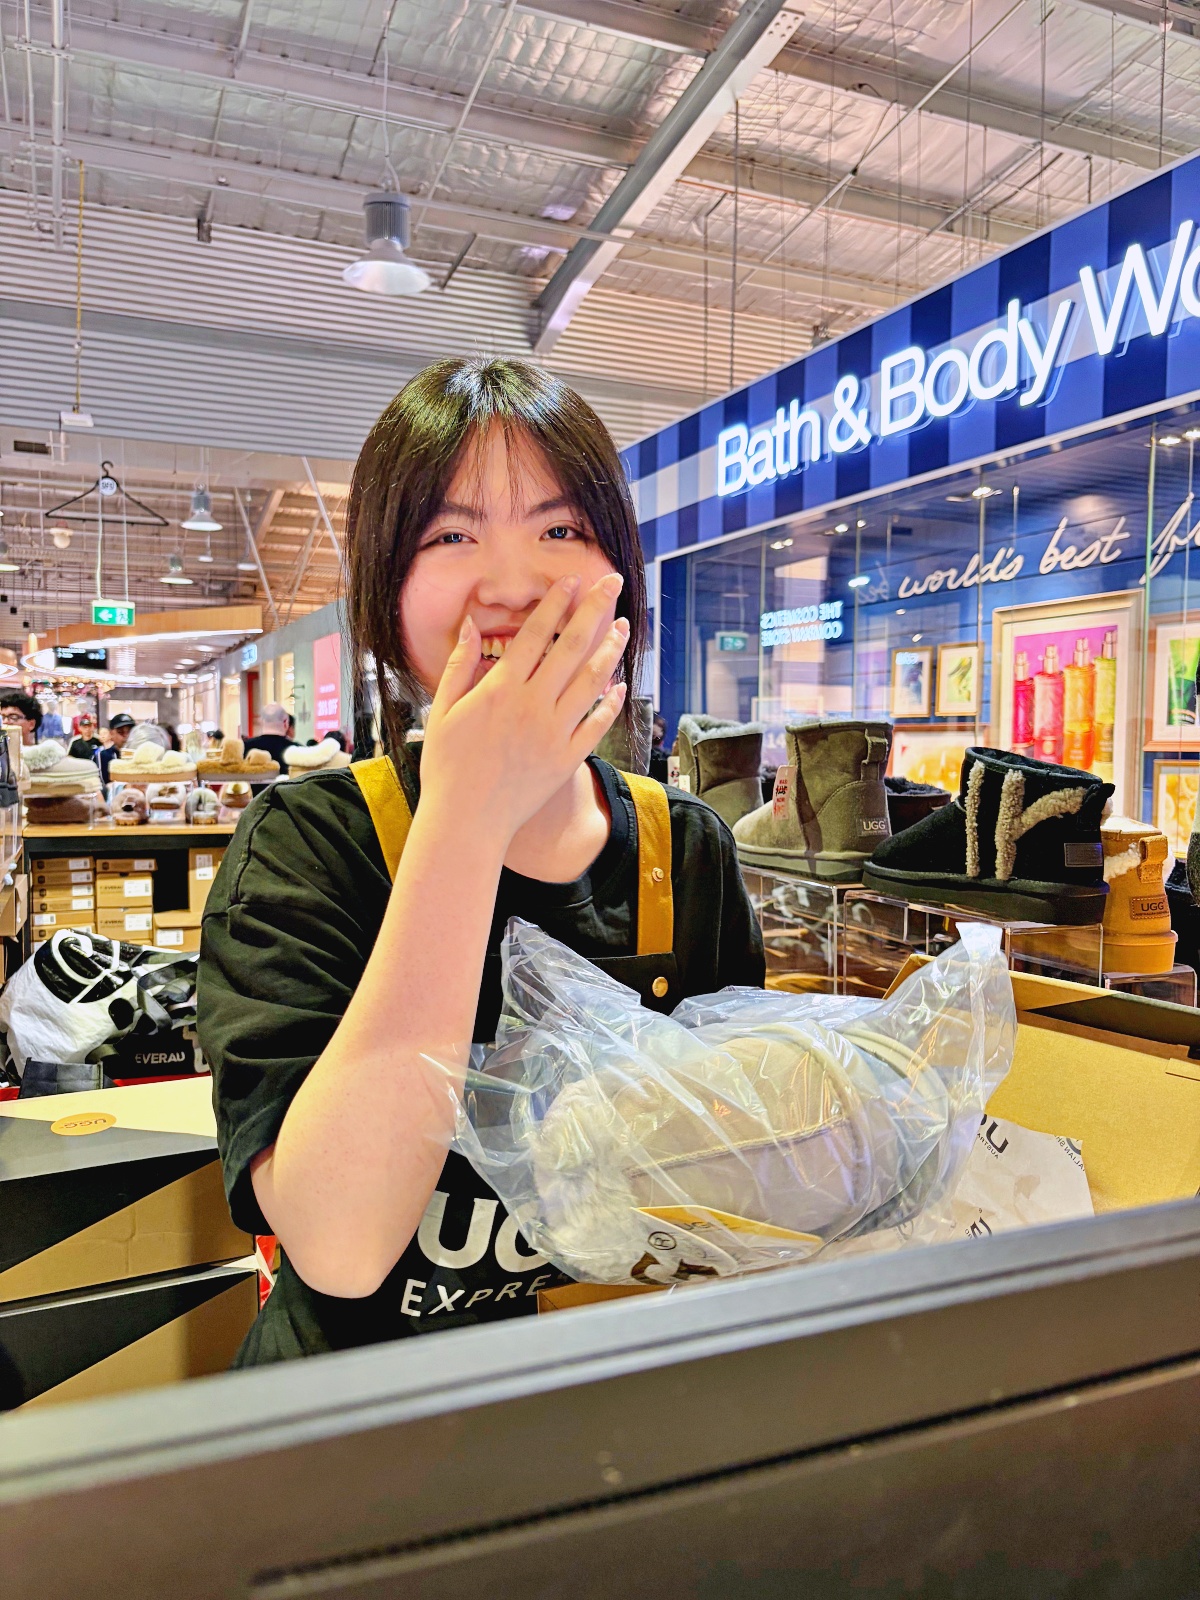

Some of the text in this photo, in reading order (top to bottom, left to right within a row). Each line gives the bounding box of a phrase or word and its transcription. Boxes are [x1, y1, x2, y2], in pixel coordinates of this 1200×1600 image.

[717, 398, 821, 497] Bath
[828, 374, 873, 454] &
[880, 299, 1072, 437] Body
[898, 546, 1024, 598] world's
[1039, 516, 1130, 575] best
[863, 820, 886, 831] UGG
[1141, 902, 1164, 912] UGG
[135, 1051, 186, 1065] EVERAU
